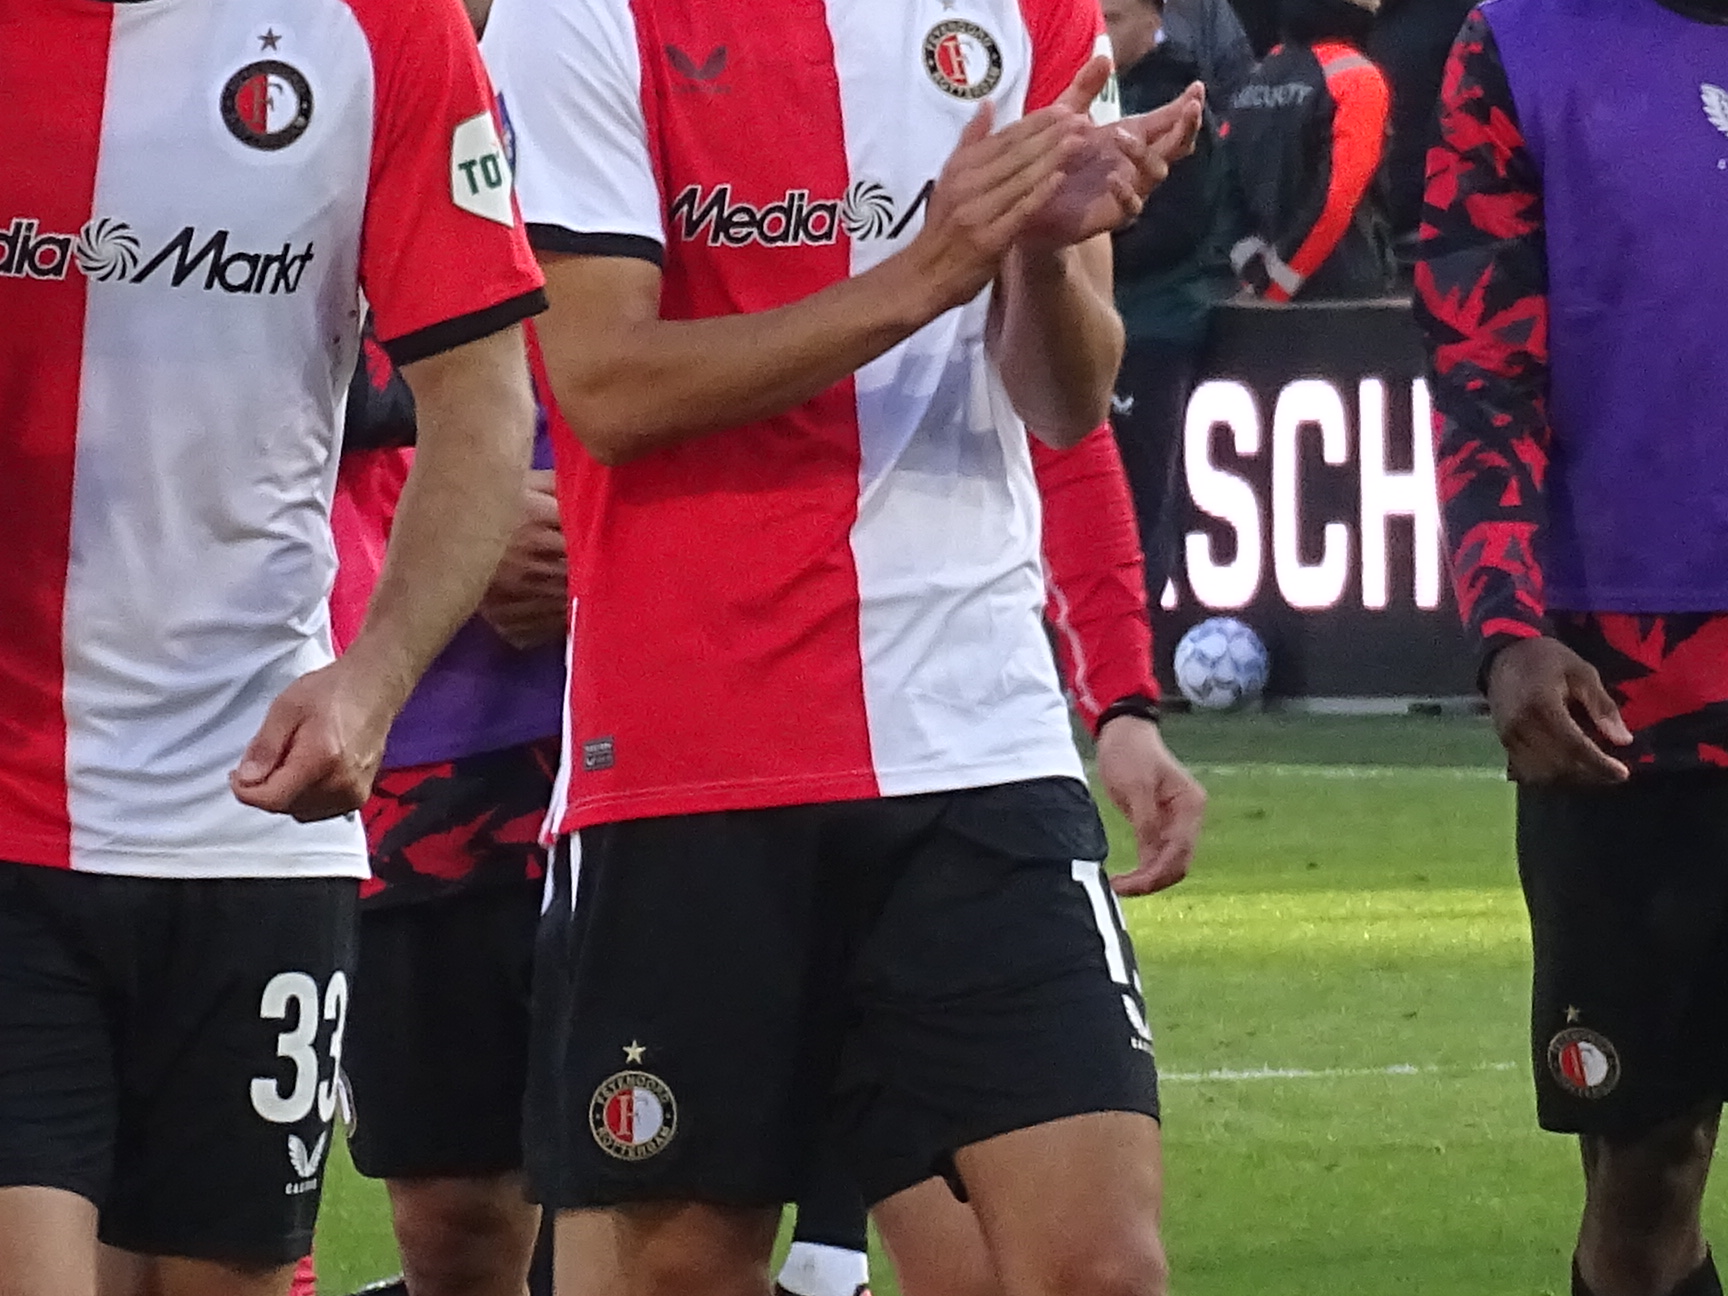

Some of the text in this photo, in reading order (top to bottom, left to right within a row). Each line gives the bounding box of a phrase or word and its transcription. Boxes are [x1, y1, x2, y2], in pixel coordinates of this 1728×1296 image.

[457, 150, 503, 196] TO
[670, 182, 840, 247] Media
[128, 226, 314, 295] Markt
[249, 969, 349, 1124] 33
